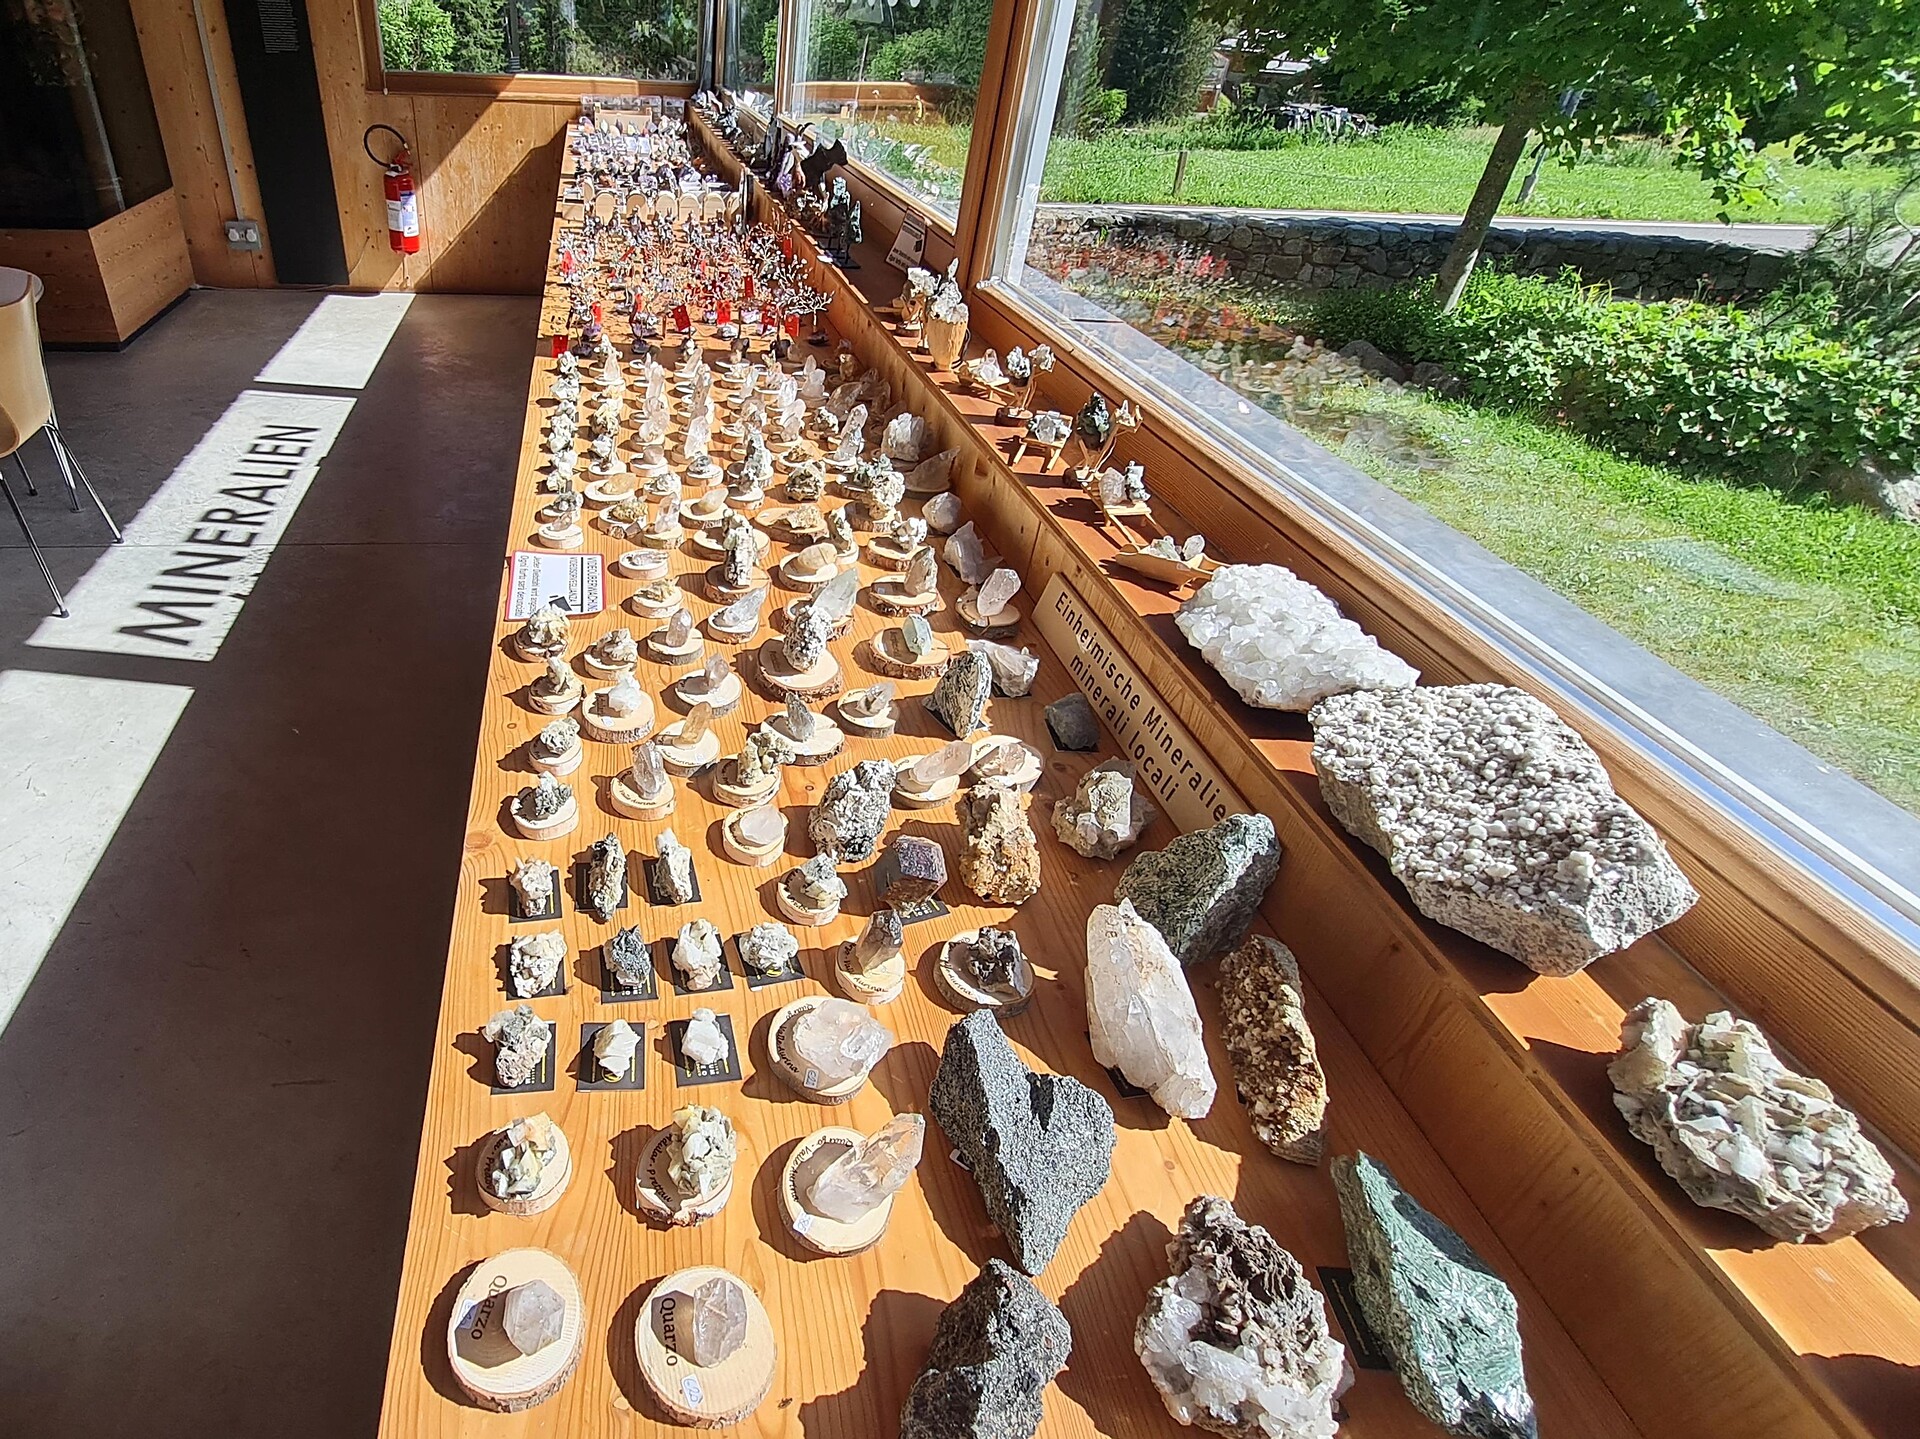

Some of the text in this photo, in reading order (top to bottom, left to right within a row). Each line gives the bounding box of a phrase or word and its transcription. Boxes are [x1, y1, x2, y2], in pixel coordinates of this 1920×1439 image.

[115, 424, 321, 646] MINERALIEN
[1055, 591, 1227, 823] Einheimische Mineralie
[1070, 654, 1180, 803] minerali locali
[646, 1168, 674, 1203] Prettau
[793, 1145, 812, 1166] Valle
[471, 1275, 508, 1340] Quarzo
[659, 1297, 678, 1367] Quarzo
